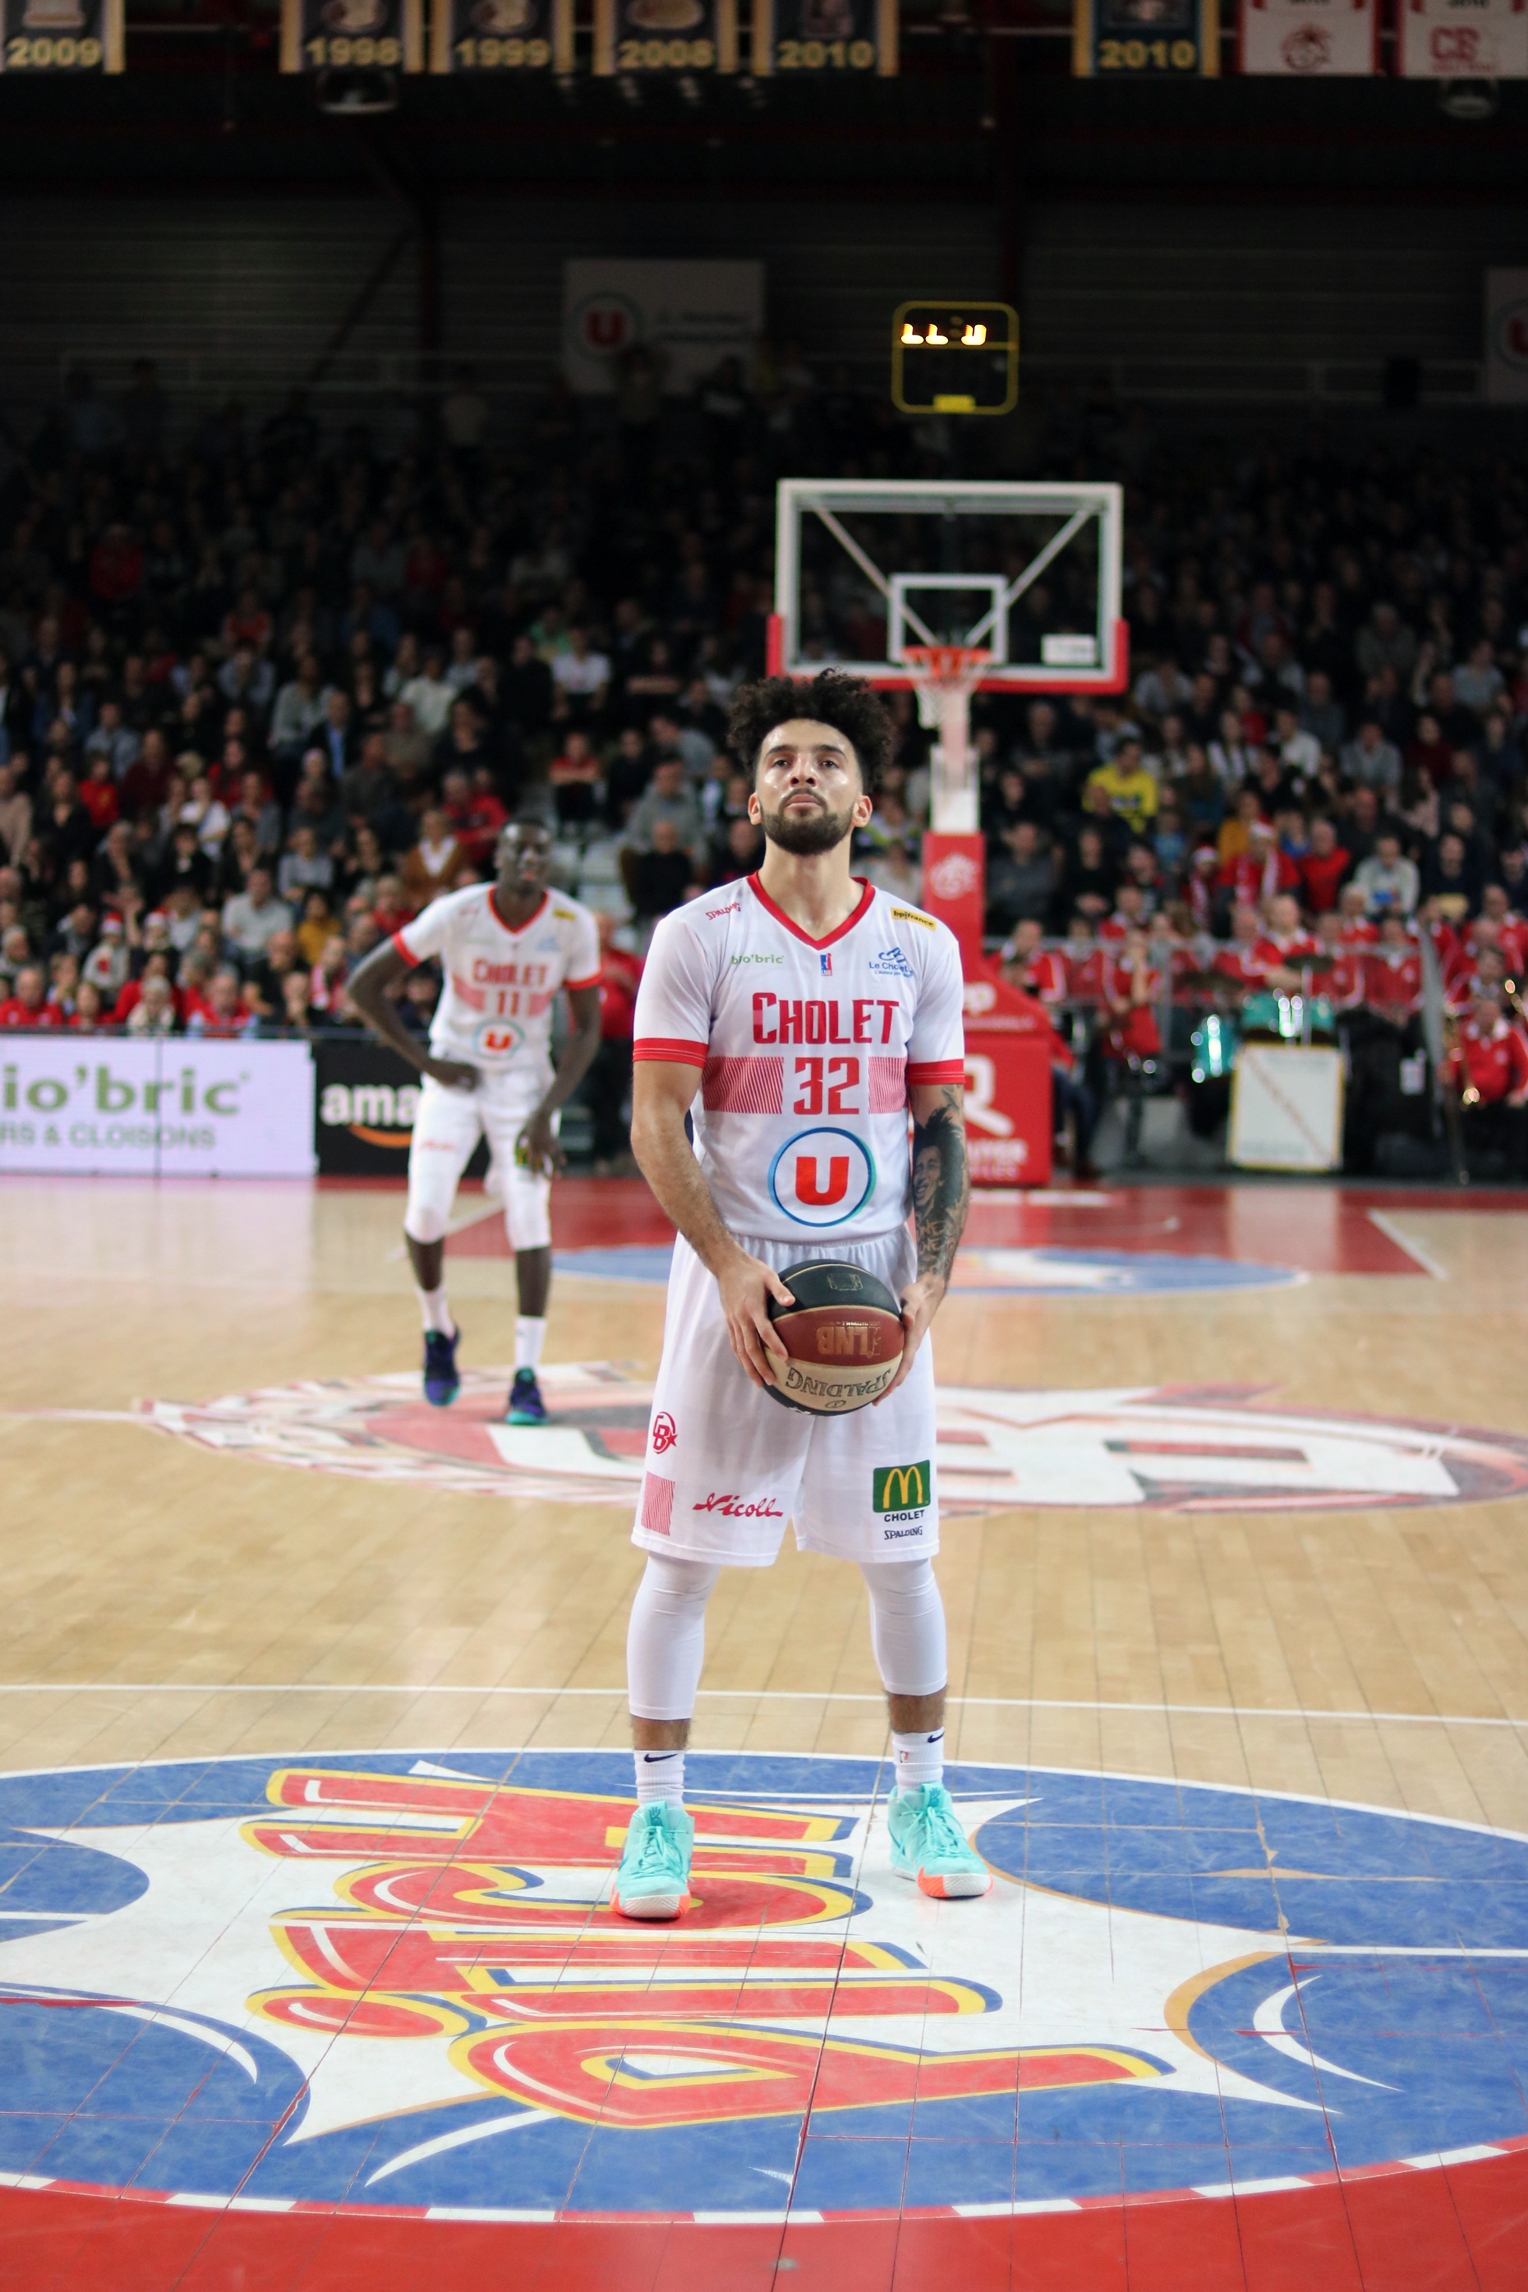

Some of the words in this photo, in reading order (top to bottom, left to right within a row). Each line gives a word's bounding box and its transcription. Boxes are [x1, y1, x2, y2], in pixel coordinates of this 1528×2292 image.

[6, 37, 101, 67] 2009
[306, 37, 400, 66] 1998
[456, 37, 551, 67] 1999
[778, 39, 874, 68] 2010
[1099, 39, 1195, 69] 2010
[497, 990, 519, 1015] 11
[752, 992, 899, 1044] CHOLET
[793, 1056, 860, 1115] 32
[795, 1156, 850, 1206] U
[816, 1326, 868, 1355] LNB
[785, 1367, 891, 1398] SPALDING
[692, 1492, 783, 1518] Nicoll
[884, 1509, 925, 1522] CHOLET
[884, 1526, 923, 1540] SPALDING
